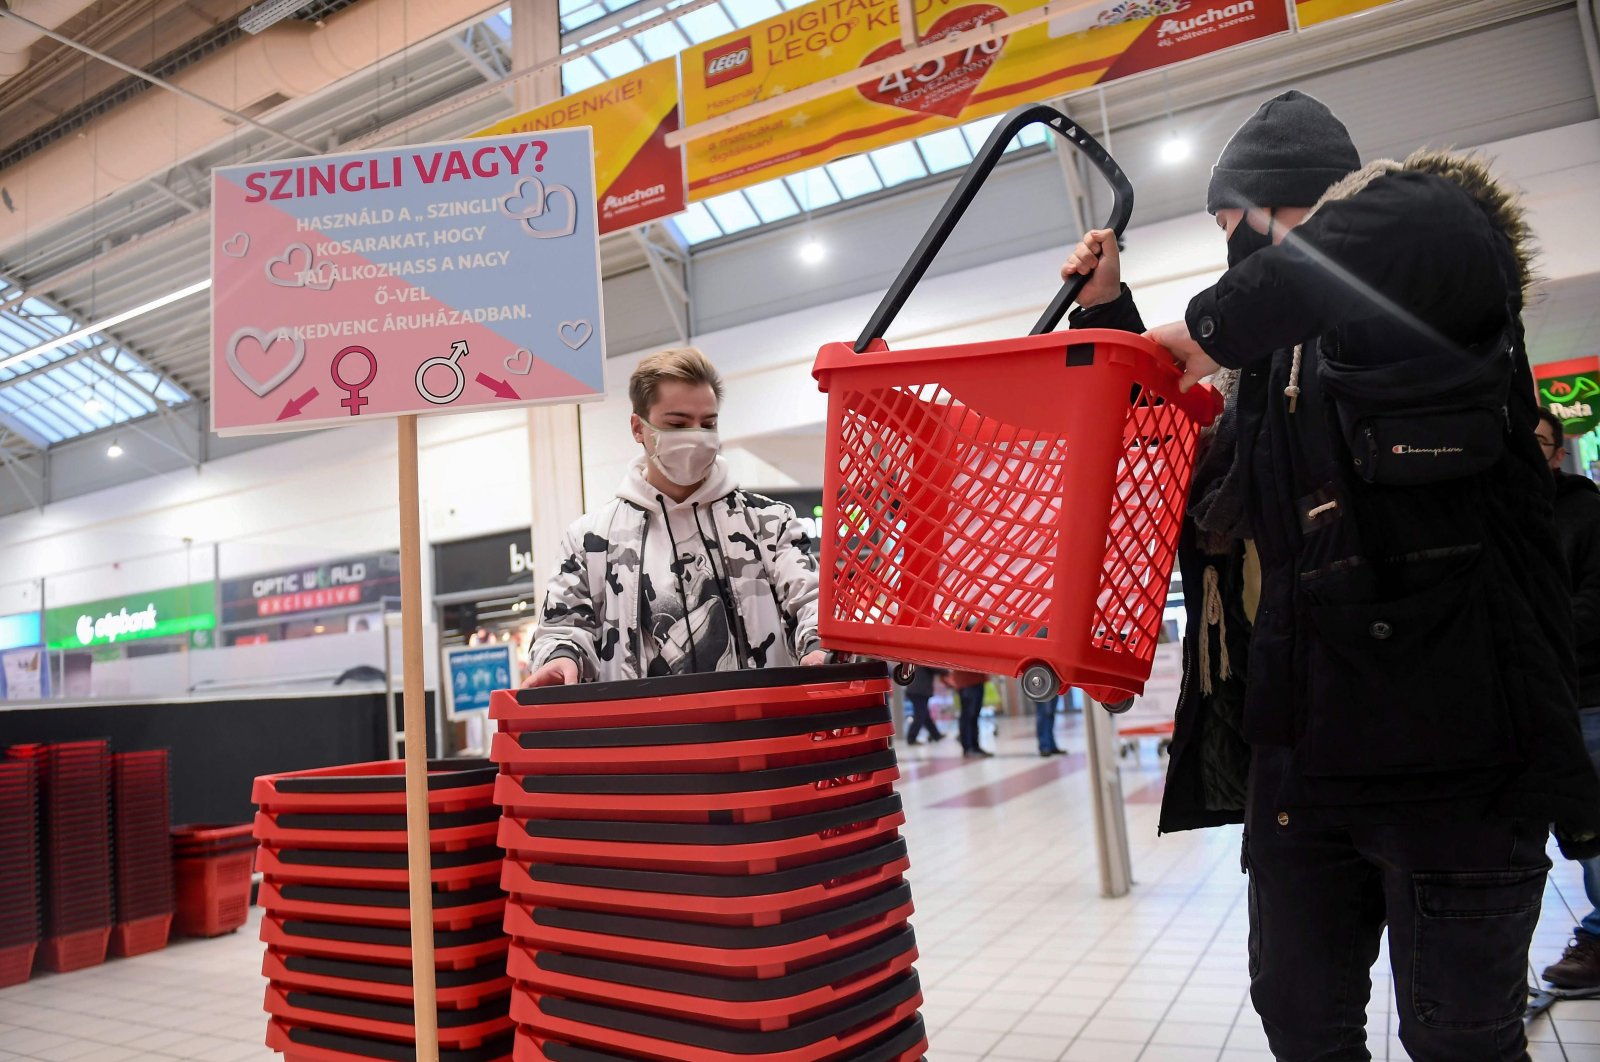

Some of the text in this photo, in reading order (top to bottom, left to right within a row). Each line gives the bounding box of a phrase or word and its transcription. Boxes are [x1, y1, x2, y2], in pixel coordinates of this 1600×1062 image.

[1156, 0, 1256, 39] Auchan
[707, 47, 750, 76] LEGO
[244, 140, 549, 203] SZINGLI VAGY?
[603, 183, 666, 212] Auchan
[296, 207, 394, 233] HASZNÁLD
[398, 207, 412, 222] A
[316, 225, 487, 257] KOSARAKAT, HOGY
[293, 250, 511, 286] TALÁLKOZHASS A NAGY
[374, 286, 431, 305] Ő-VEL
[276, 303, 533, 343] A KEDVENC ÁRUHÁZADBAN.
[1392, 444, 1463, 457] Champion
[252, 573, 299, 599] OPTIC
